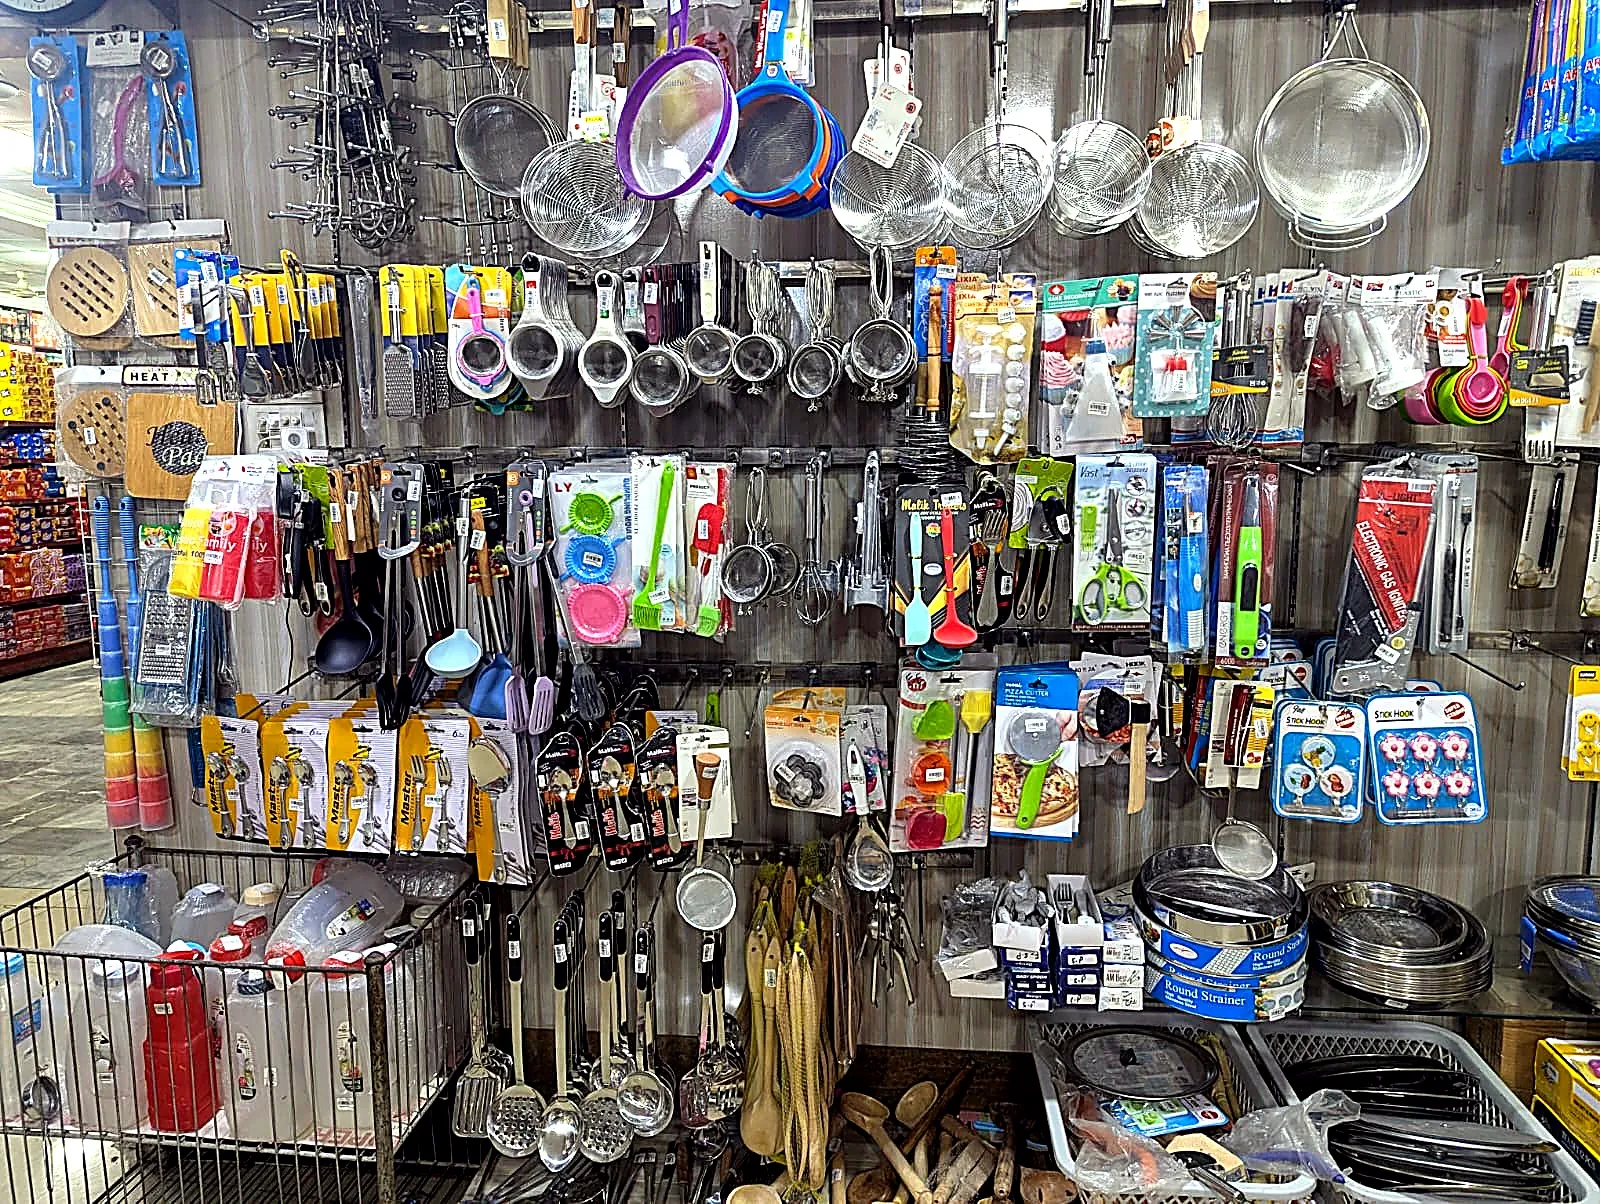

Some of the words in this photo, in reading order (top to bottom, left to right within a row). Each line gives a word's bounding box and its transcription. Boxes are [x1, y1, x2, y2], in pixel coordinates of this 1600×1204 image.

[130, 372, 169, 382] HEAT
[554, 481, 572, 493] LY
[1356, 520, 1389, 571] ELECTRONIC
[1380, 571, 1397, 590] GAS
[1374, 709, 1393, 719] STICK
[1394, 709, 1414, 718] HOOK
[208, 769, 221, 815] Maste
[330, 775, 342, 825] Maste
[400, 770, 412, 825] Master
[1253, 947, 1285, 962] Round
[1165, 978, 1199, 999] Round
[1201, 990, 1247, 1006] Strainer
